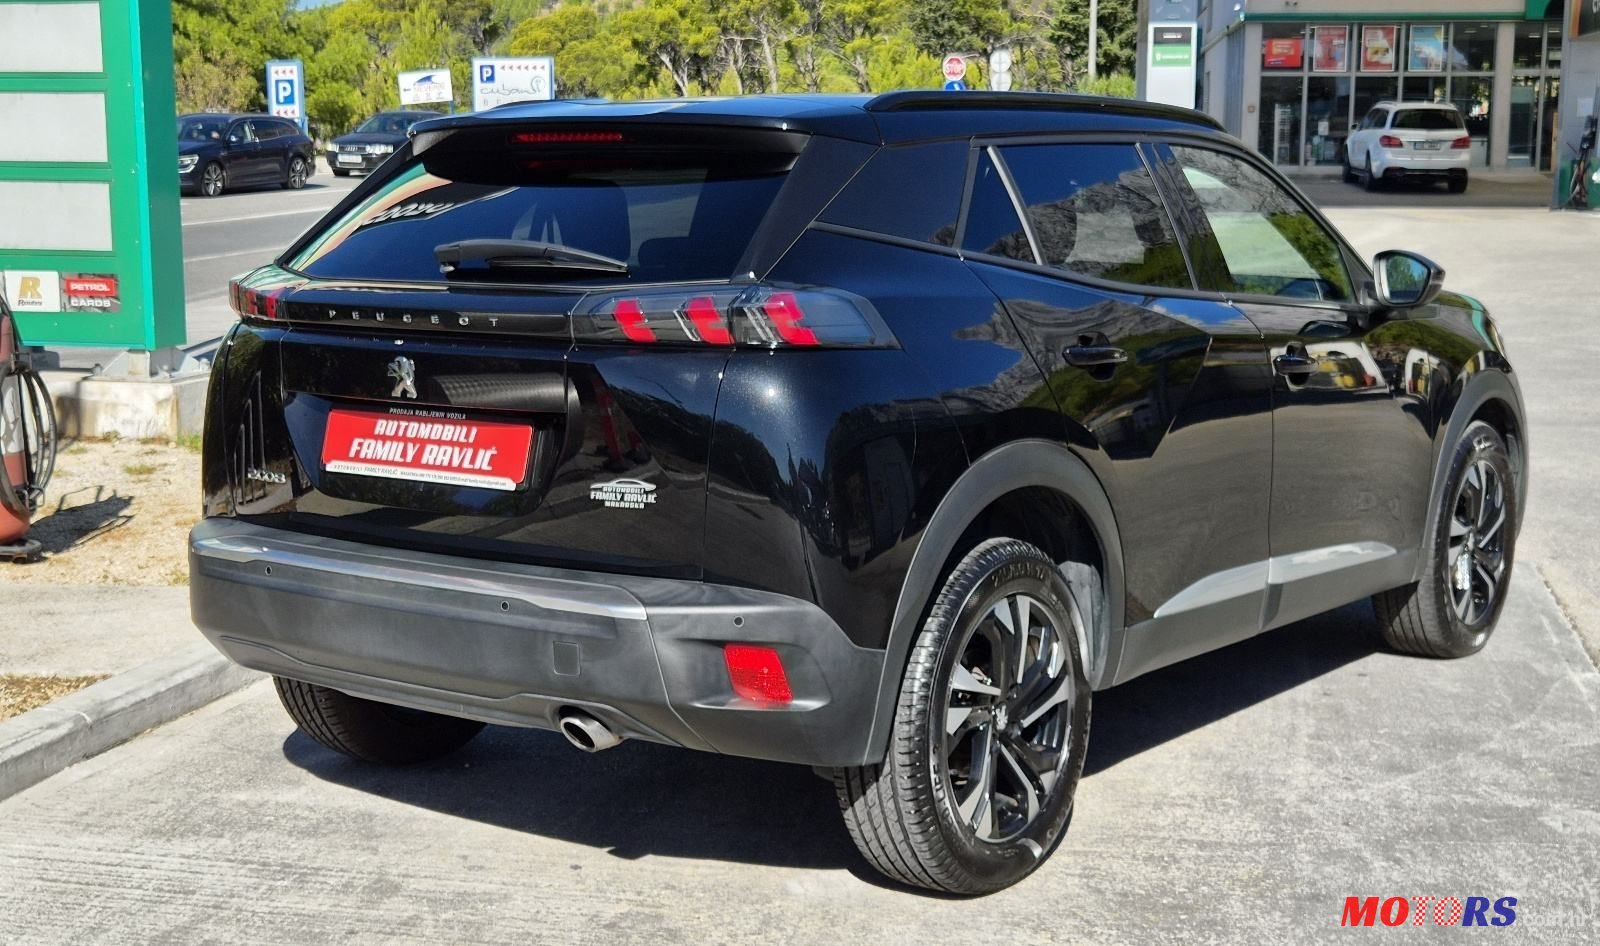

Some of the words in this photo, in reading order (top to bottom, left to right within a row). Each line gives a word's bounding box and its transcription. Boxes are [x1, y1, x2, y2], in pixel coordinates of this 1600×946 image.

[279, 82, 291, 101] P
[70, 282, 111, 292] PETROL
[70, 298, 111, 308] CARDS
[328, 310, 498, 327] PEUGEOT
[374, 419, 478, 444] AUTOMOBILI
[348, 437, 419, 463] FAMILY
[420, 444, 498, 471] RAVLIĆ
[590, 491, 622, 501] FAMILY
[602, 486, 645, 494] AUTOMOBILI
